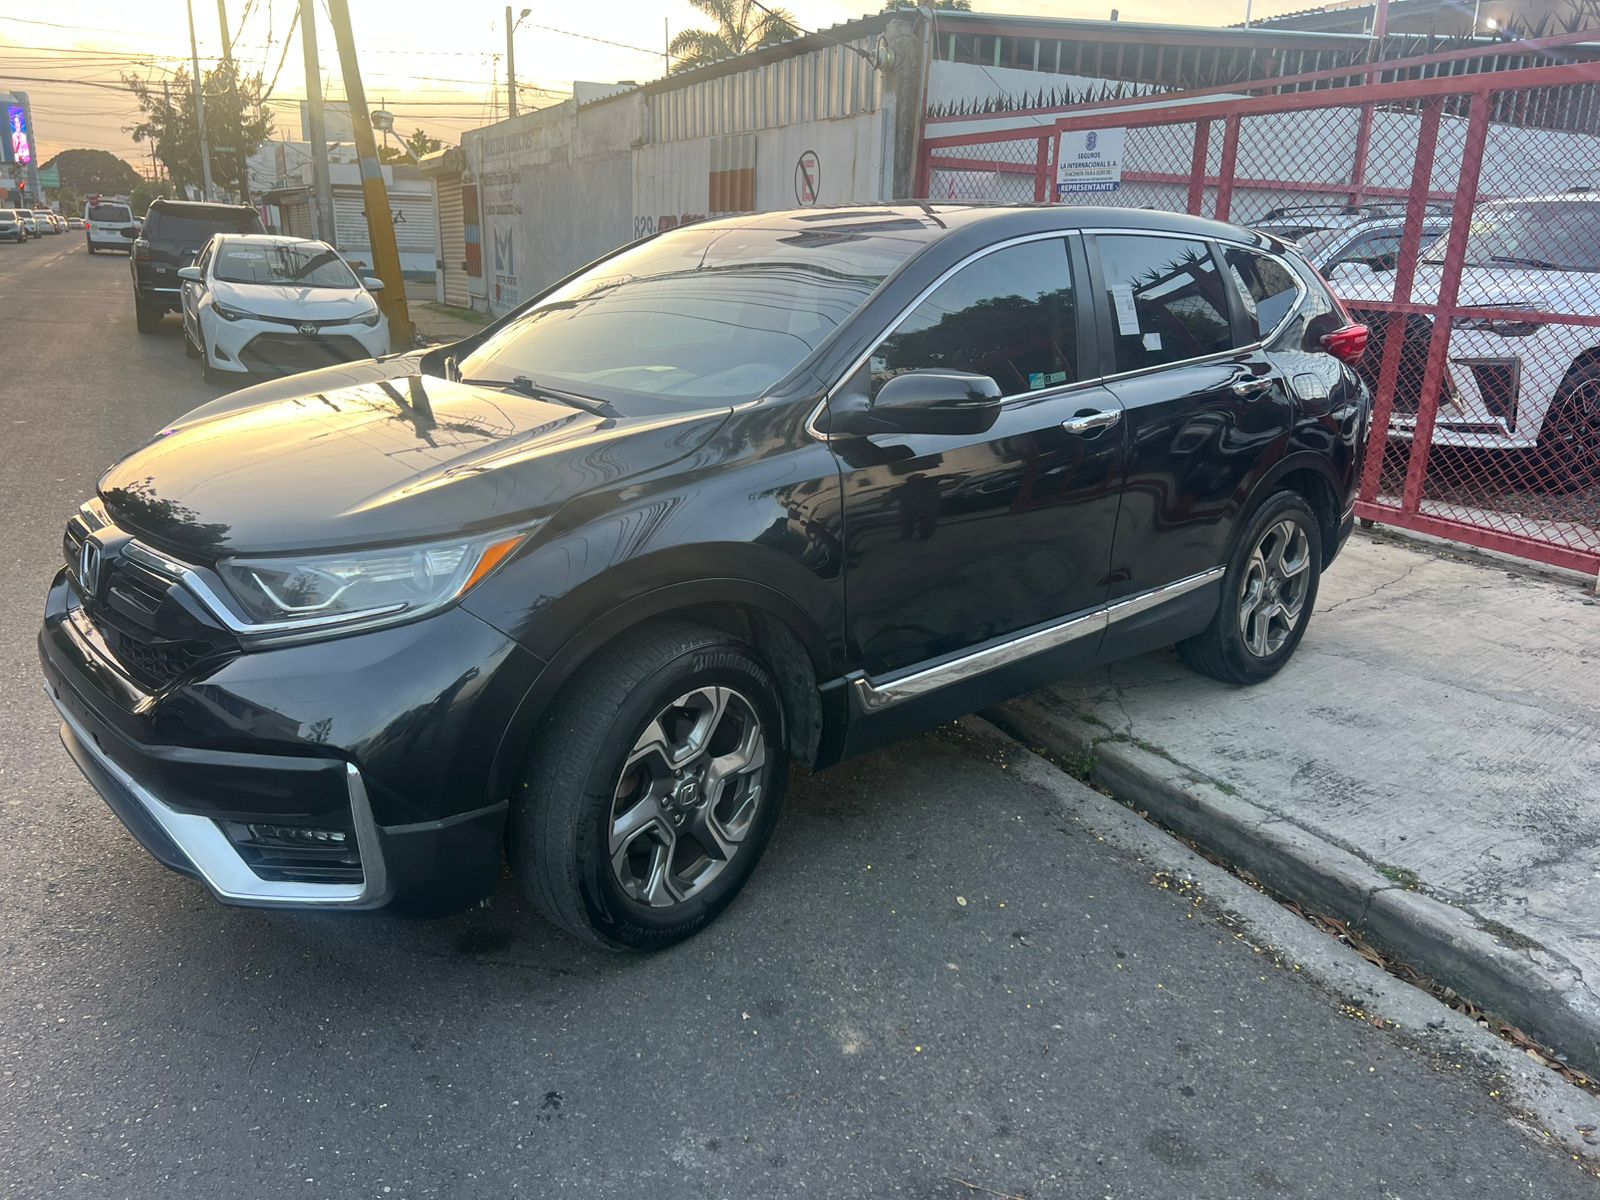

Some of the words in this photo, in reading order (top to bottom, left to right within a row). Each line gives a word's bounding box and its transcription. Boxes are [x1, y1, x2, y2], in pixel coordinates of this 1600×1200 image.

[1067, 161, 1106, 169] INTERNACIONAL
[1060, 183, 1114, 191] REPRESENTANTE
[692, 653, 770, 688] BRIDGESTONE
